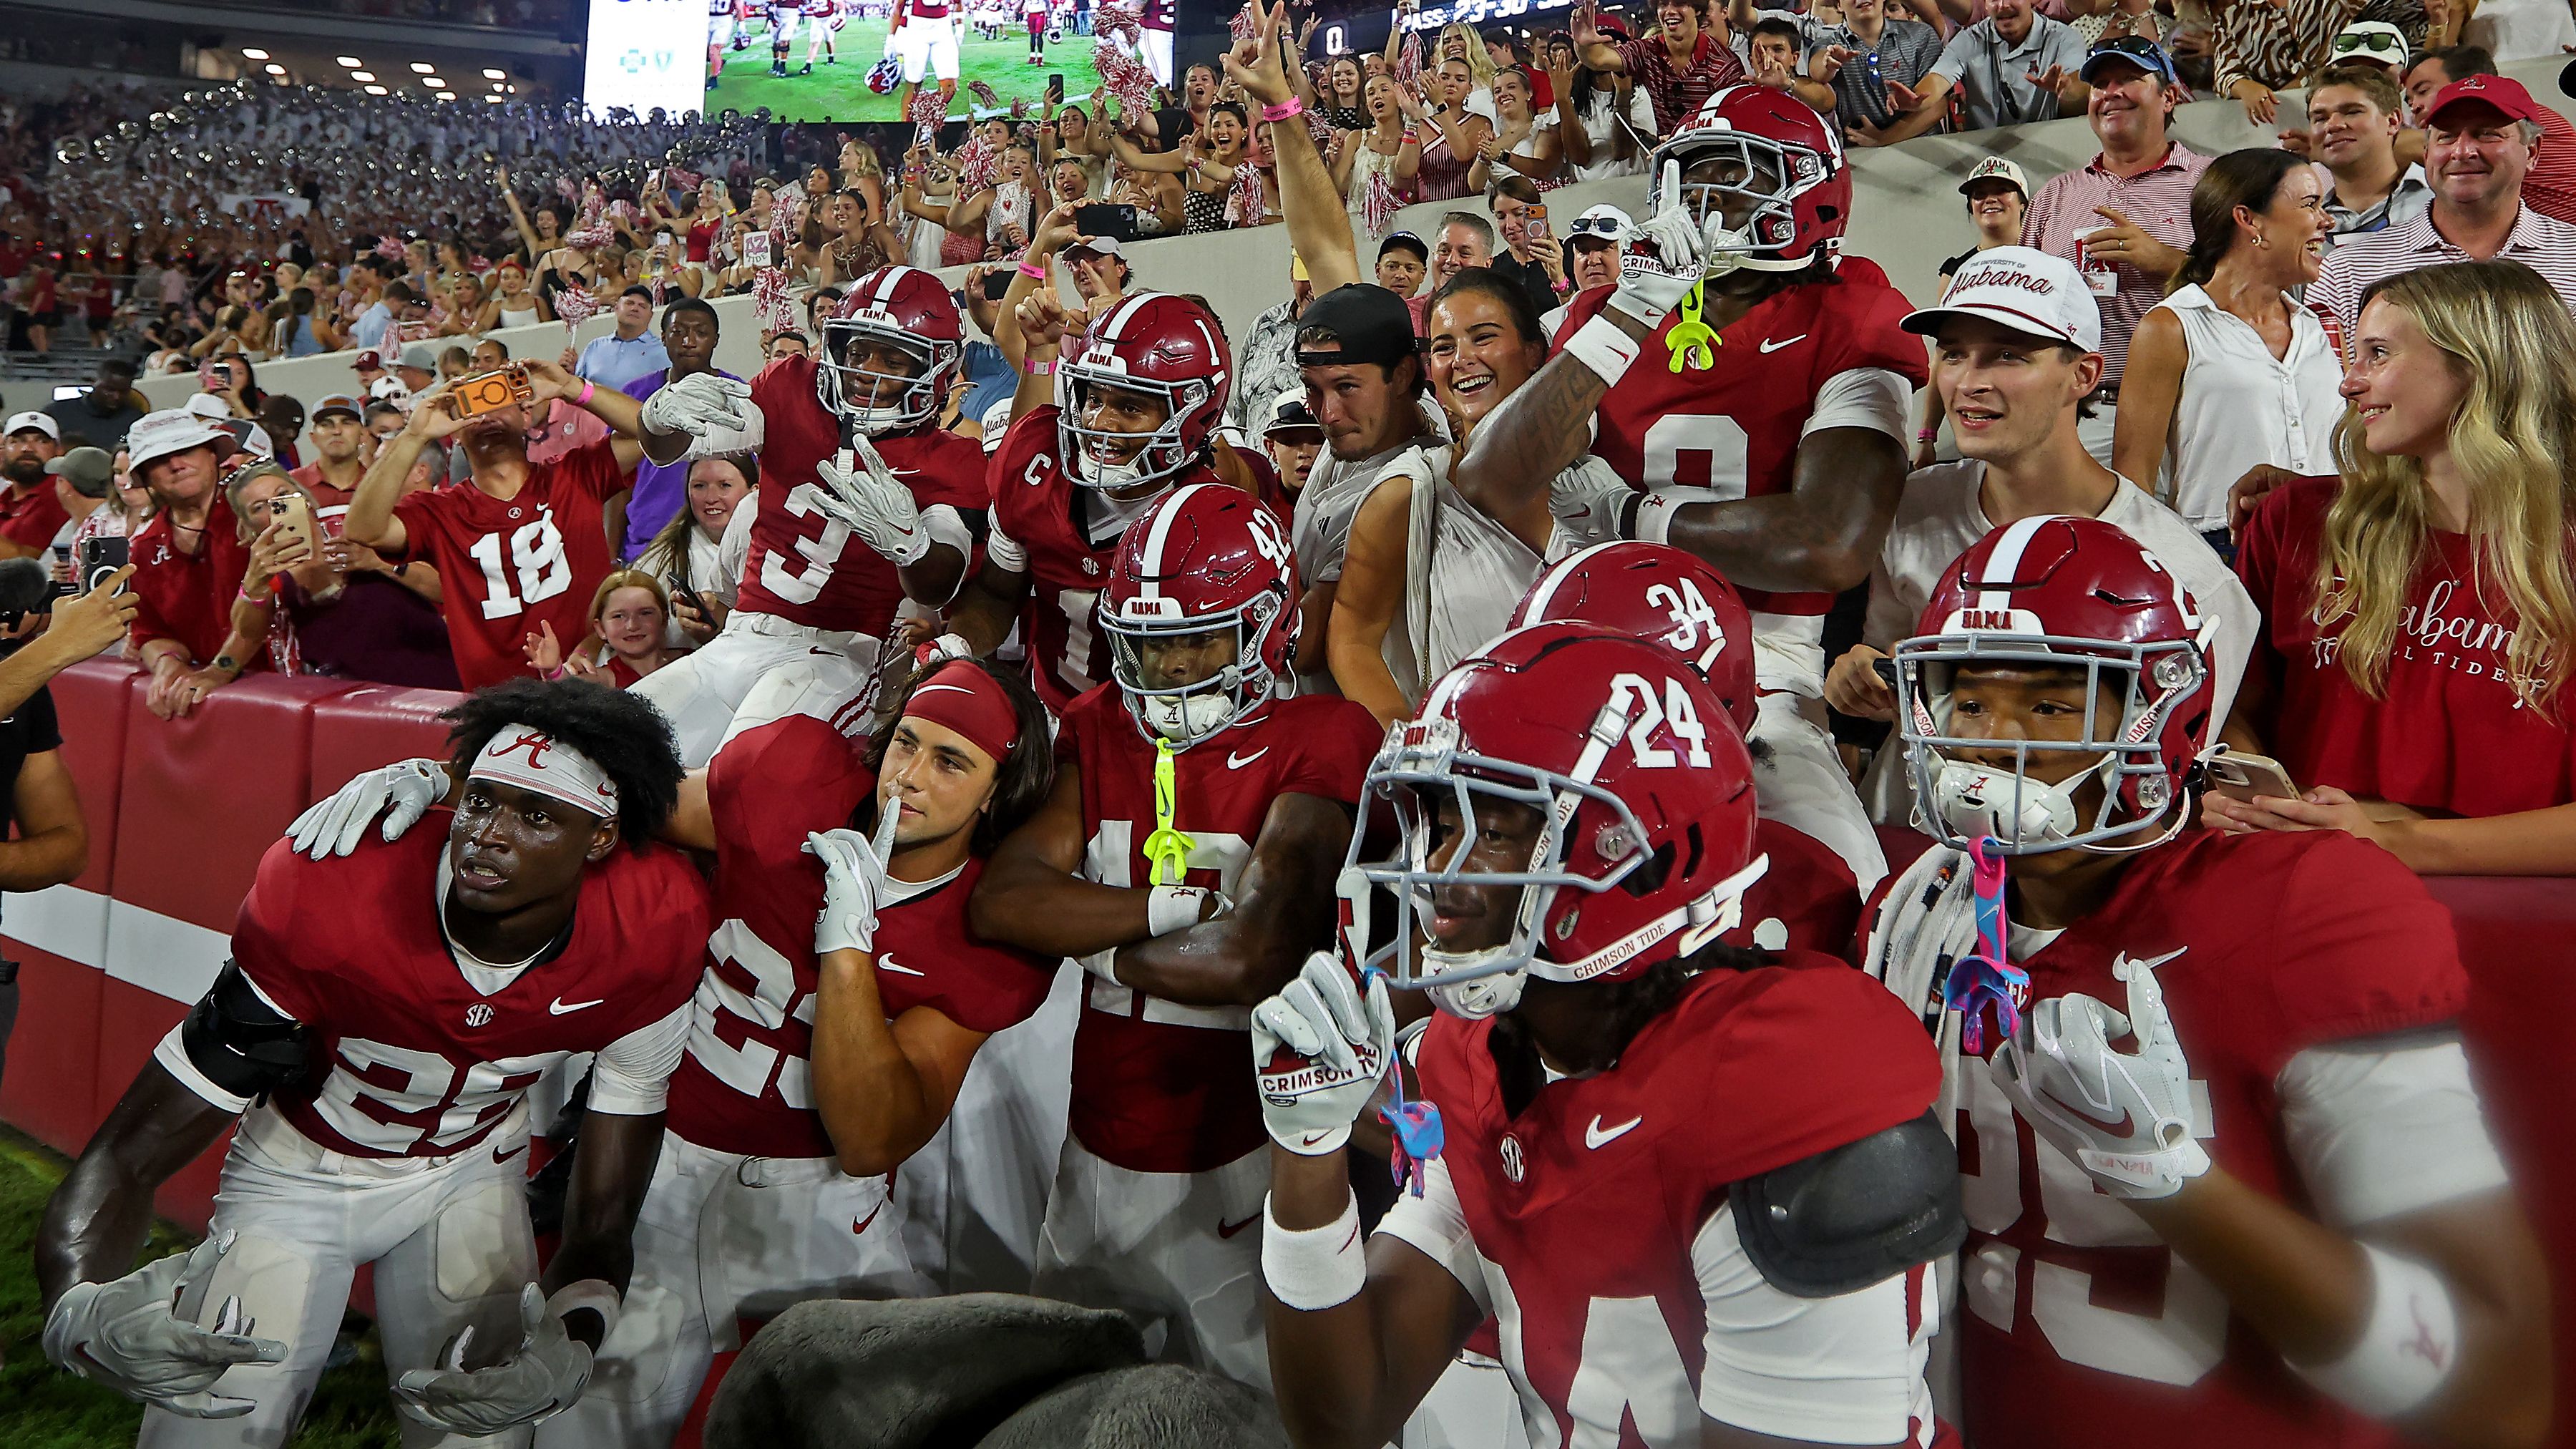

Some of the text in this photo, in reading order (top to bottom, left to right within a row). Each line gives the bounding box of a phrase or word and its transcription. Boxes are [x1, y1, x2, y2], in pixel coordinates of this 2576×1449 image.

[1327, 26, 1342, 55] 0
[1974, 160, 2011, 176] ALABAMA
[747, 253, 767, 263] TIDE
[1942, 265, 2054, 307] Alabama
[862, 309, 886, 321] BAMA
[1194, 319, 1220, 366] 1
[1087, 352, 1112, 367] BAMA
[1024, 453, 1051, 486] C
[761, 482, 852, 605] 3
[1246, 508, 1291, 570] 42
[470, 509, 572, 620] 18
[1082, 557, 1100, 575] SEC
[1131, 601, 1161, 615] BAMA
[1646, 577, 1723, 651] 34
[1962, 610, 2012, 630] BAMA
[2433, 652, 2507, 683] TIDE
[1610, 673, 1712, 768] 24
[1574, 923, 1667, 979] CRIMSON TIDE
[465, 1003, 495, 1028] SEC
[1263, 1068, 1354, 1092] CRIMSON
[1501, 1136, 1524, 1183] SEC
